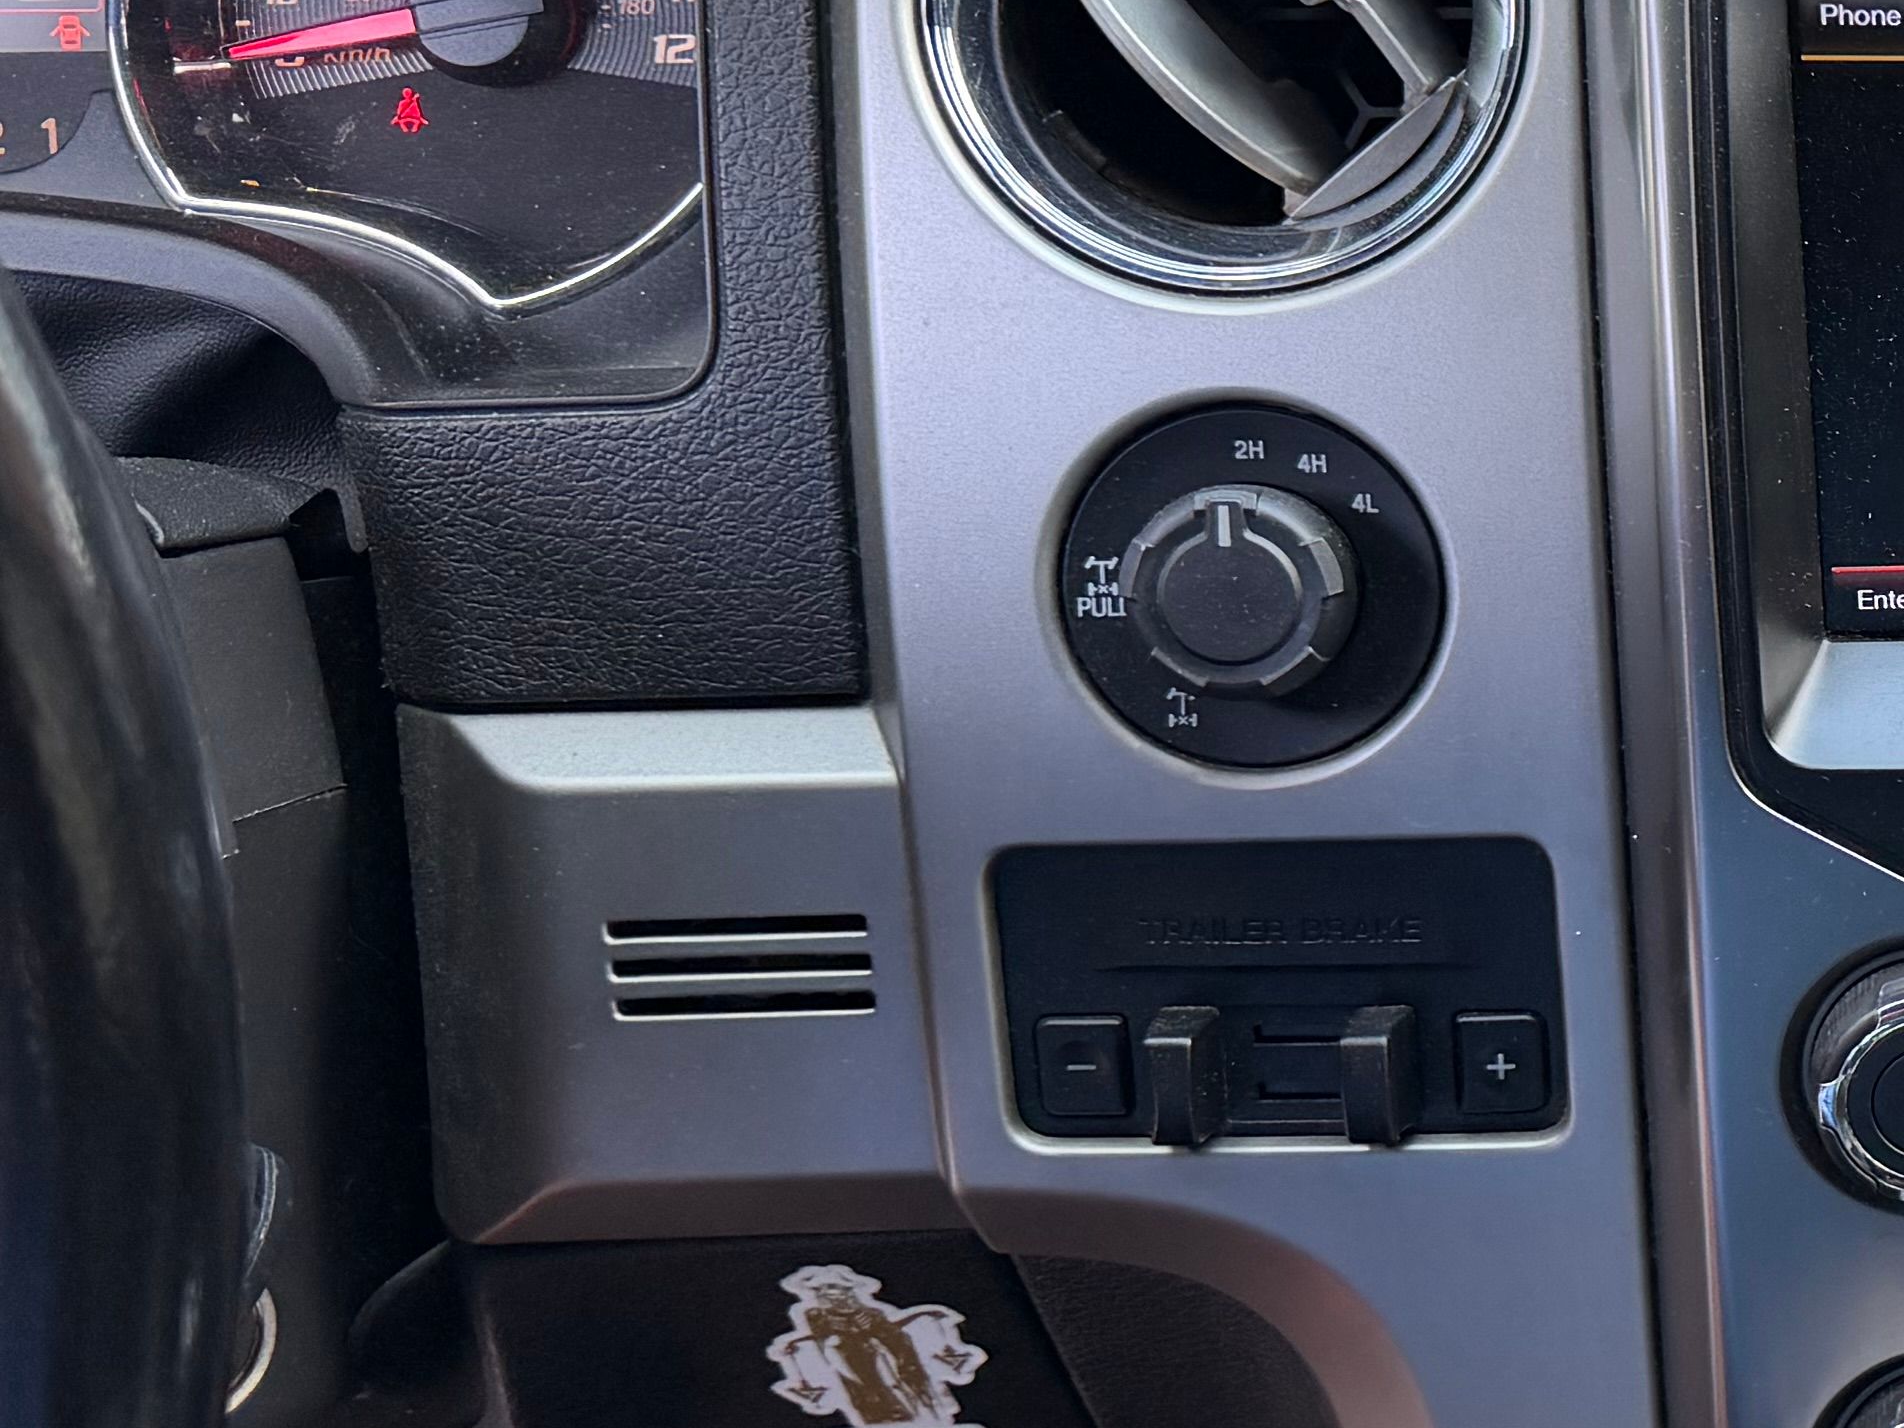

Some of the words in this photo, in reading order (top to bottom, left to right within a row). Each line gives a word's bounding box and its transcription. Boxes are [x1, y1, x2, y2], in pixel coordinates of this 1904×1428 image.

[1818, 3, 1902, 27] Phone
[1233, 439, 1265, 461] 2H
[1296, 452, 1328, 475] 4H
[1351, 493, 1380, 514] 4L
[1076, 596, 1127, 618] PULL
[1141, 918, 1287, 946] TRAILER
[1300, 917, 1424, 944] BRAKE
